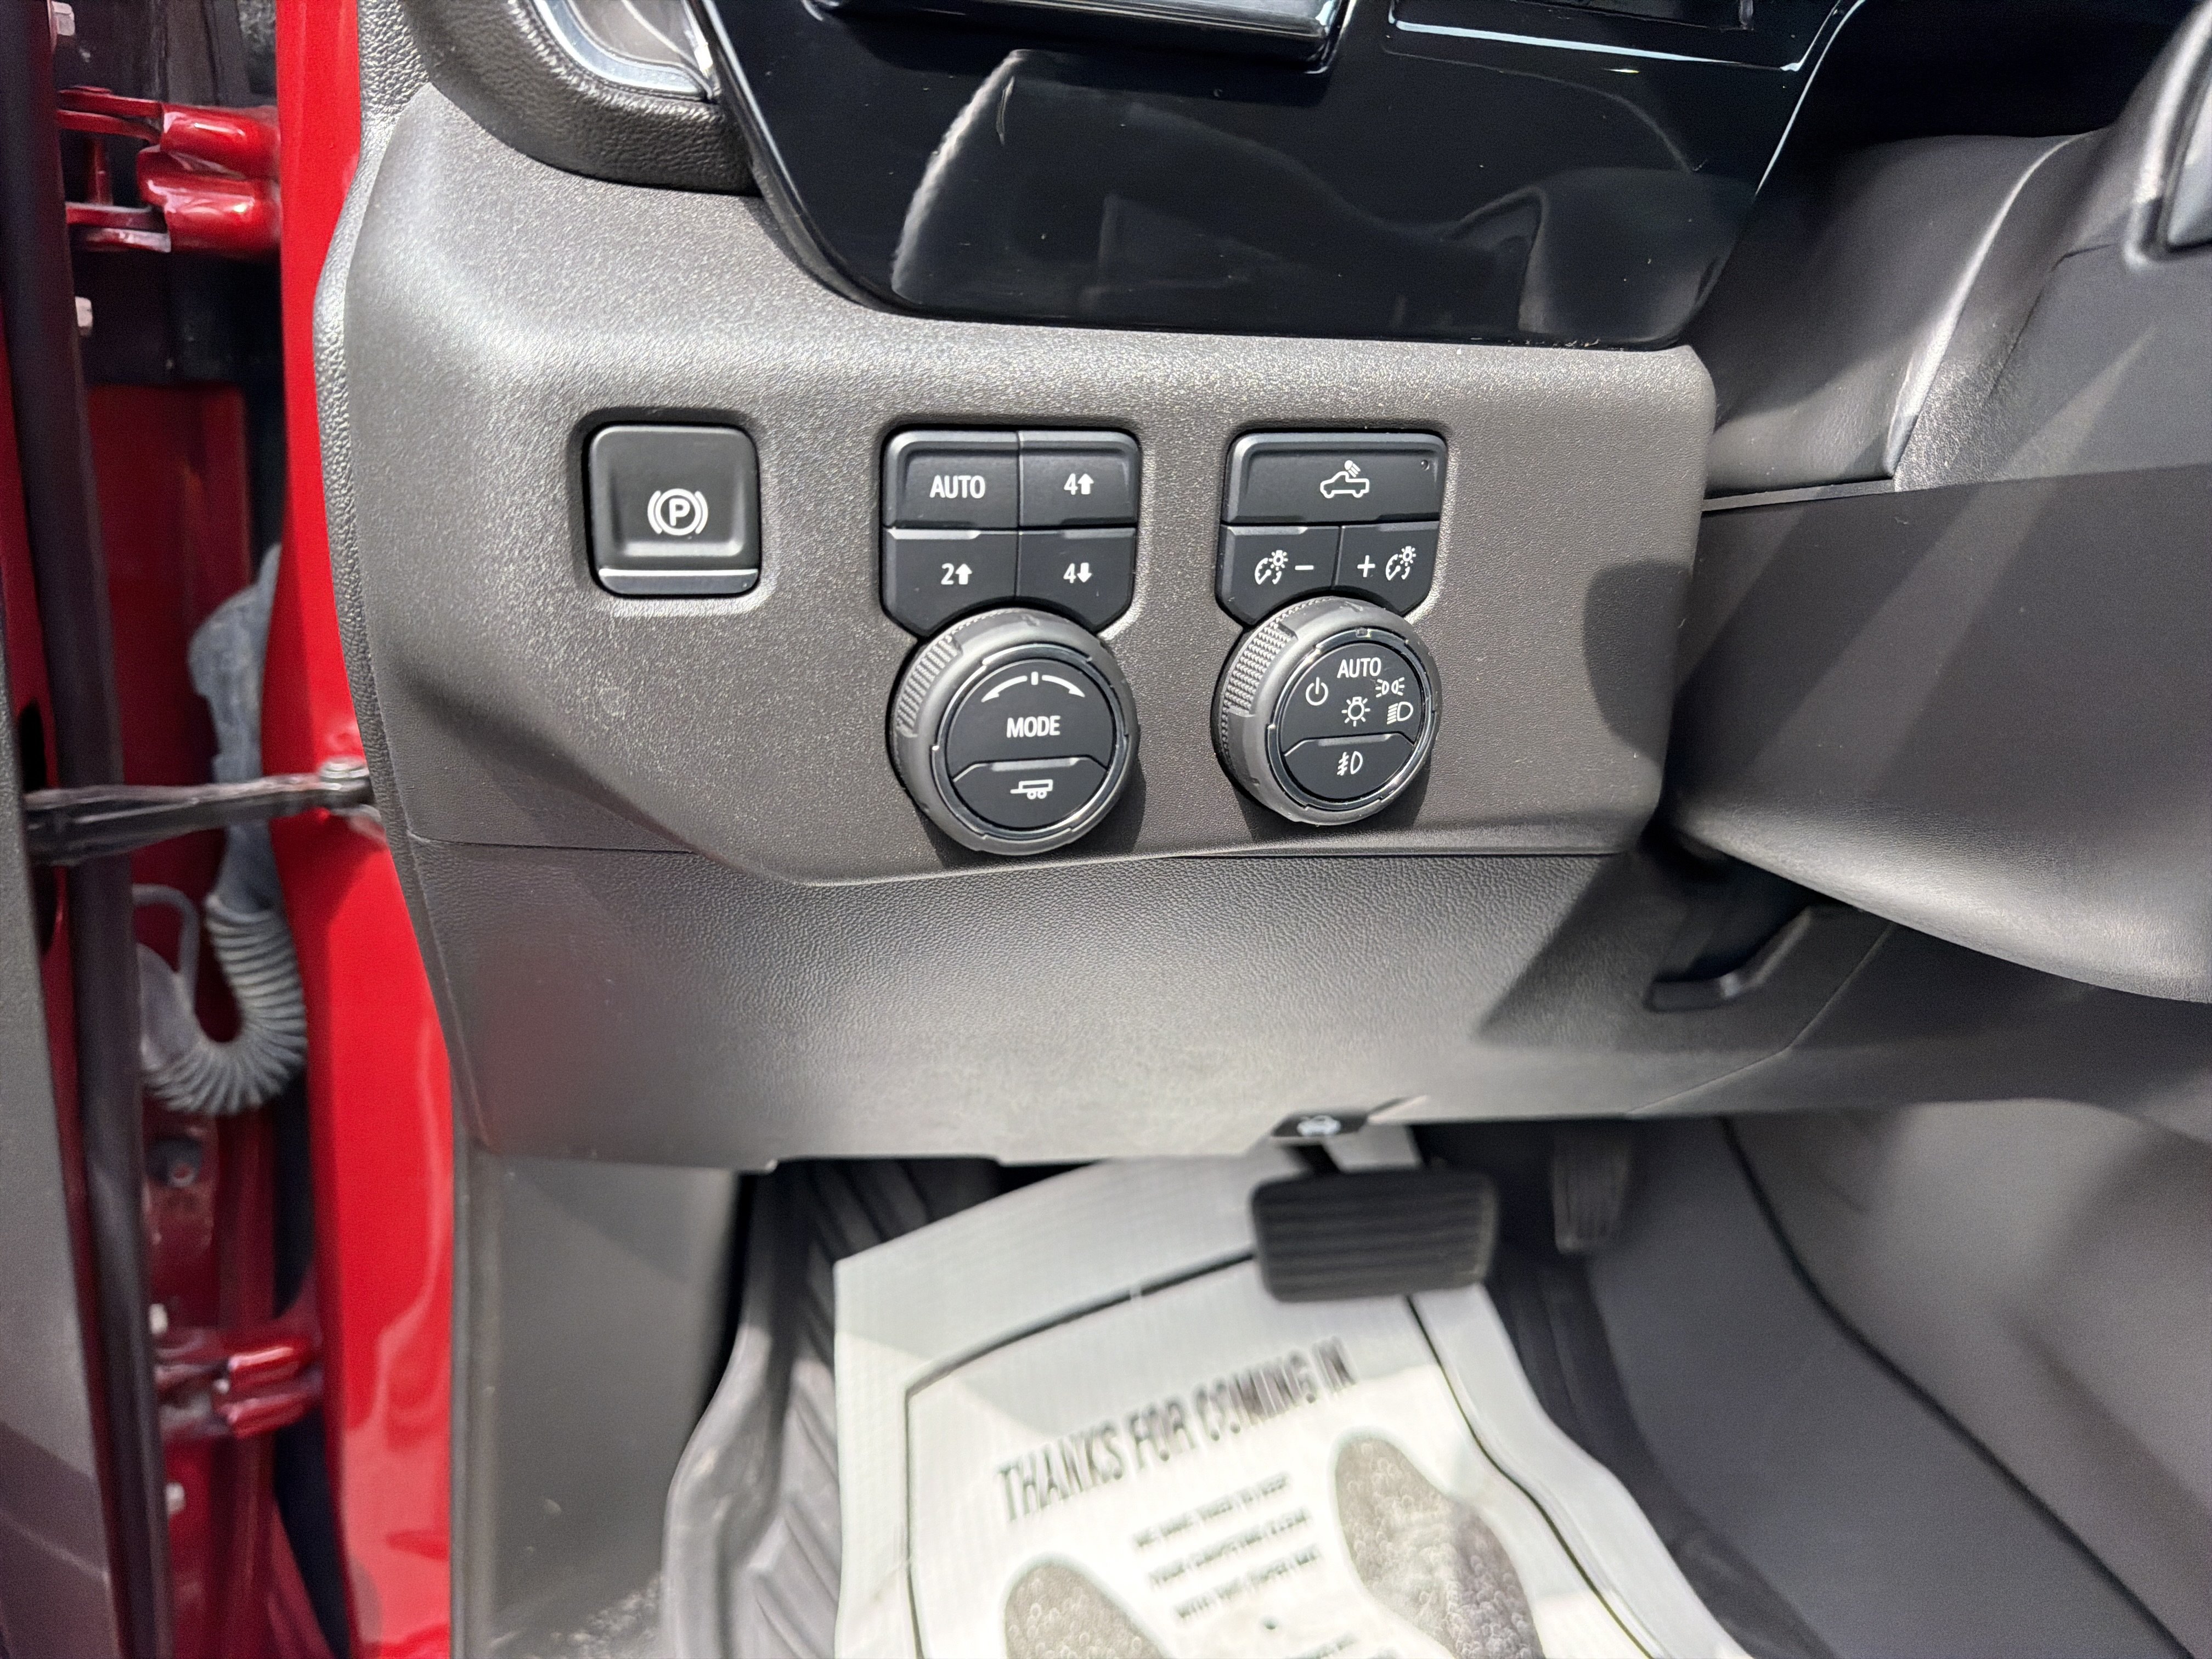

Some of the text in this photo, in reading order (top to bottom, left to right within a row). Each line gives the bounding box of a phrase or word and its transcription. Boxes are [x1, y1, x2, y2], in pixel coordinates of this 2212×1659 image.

[929, 475, 986, 499] AUTO
[669, 498, 691, 527] P
[1337, 657, 1381, 679] AUTO
[1006, 715, 1061, 738] MODE
[997, 1419, 1125, 1521] THANKS
[1127, 1397, 1195, 1470] FOR
[1196, 1350, 1317, 1442] COMING
[1316, 1337, 1358, 1393] IN
